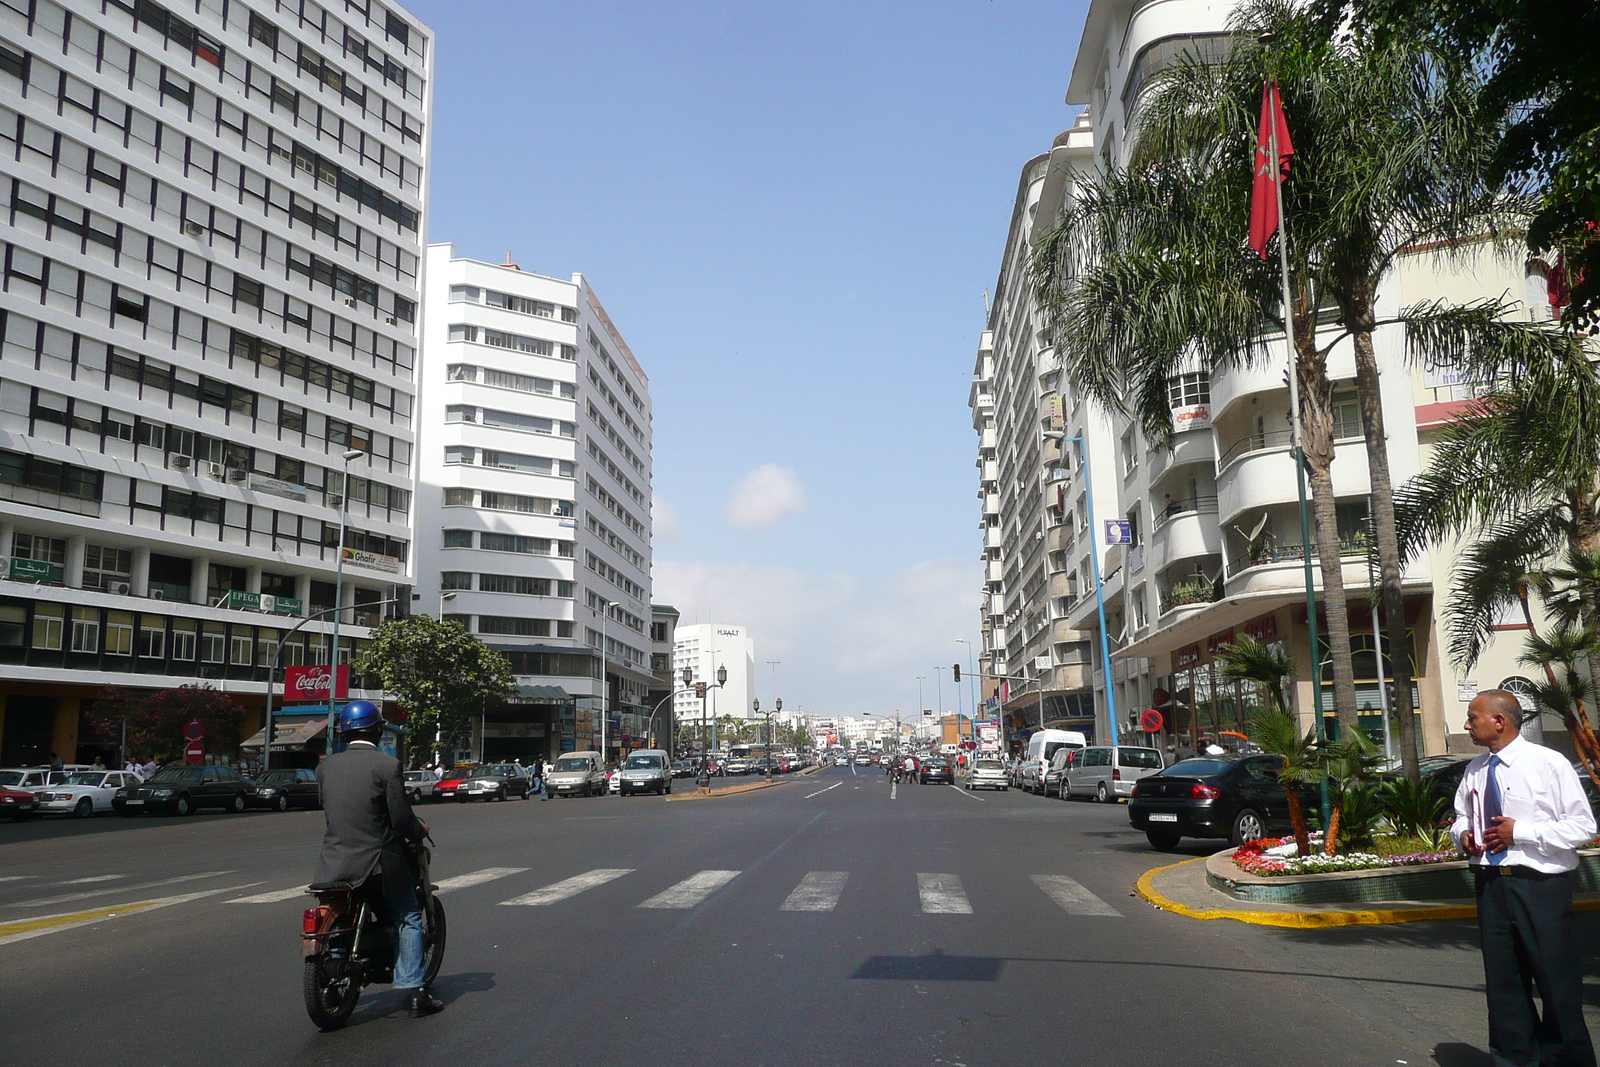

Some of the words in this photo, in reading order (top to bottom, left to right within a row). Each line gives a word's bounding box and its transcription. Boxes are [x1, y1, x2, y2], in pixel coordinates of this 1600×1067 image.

[355, 551, 376, 565] Ghafir
[232, 591, 260, 604] EPEGA
[717, 628, 739, 637] HYATT
[295, 674, 332, 691] Coca-Col
[259, 745, 287, 753] DRACELL
